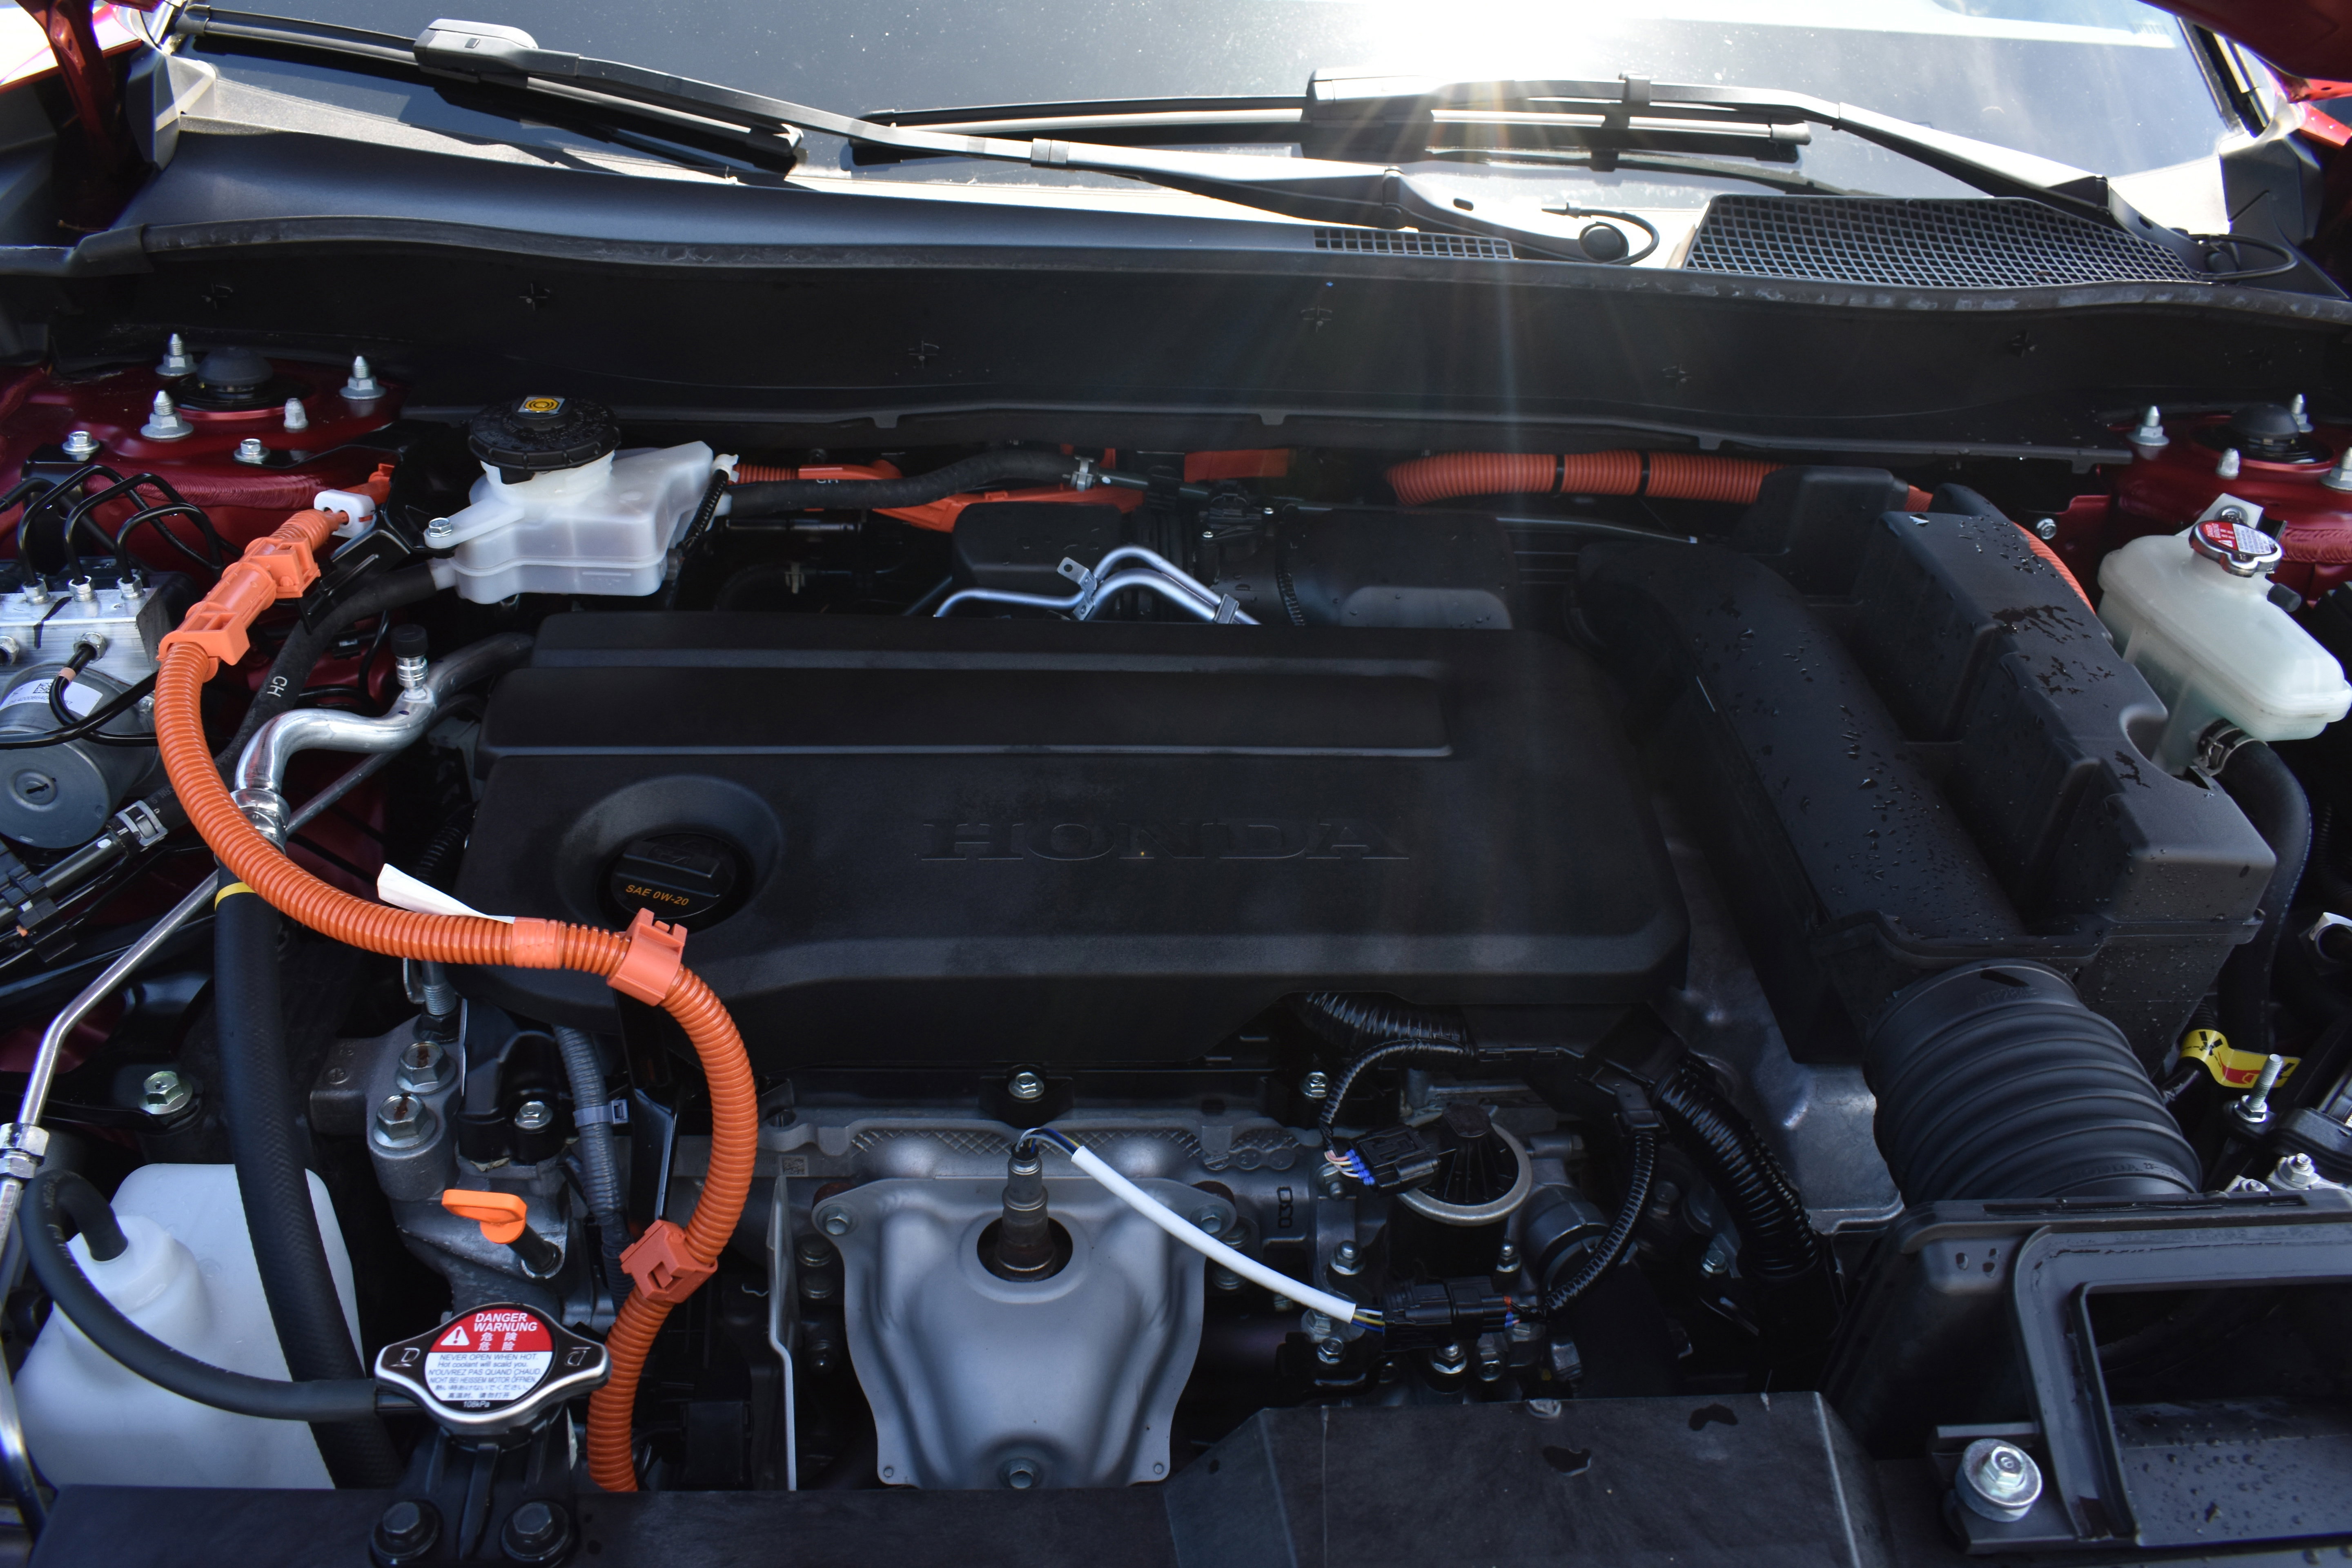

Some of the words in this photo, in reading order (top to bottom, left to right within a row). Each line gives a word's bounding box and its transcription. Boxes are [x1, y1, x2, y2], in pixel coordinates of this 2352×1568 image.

[267, 676, 287, 697] CH
[921, 821, 1410, 860] HONDA
[626, 884, 652, 896] SAE
[653, 891, 689, 906] 0W-20
[474, 1322, 538, 1332] WARNUNG
[475, 1313, 528, 1322] DANGER
